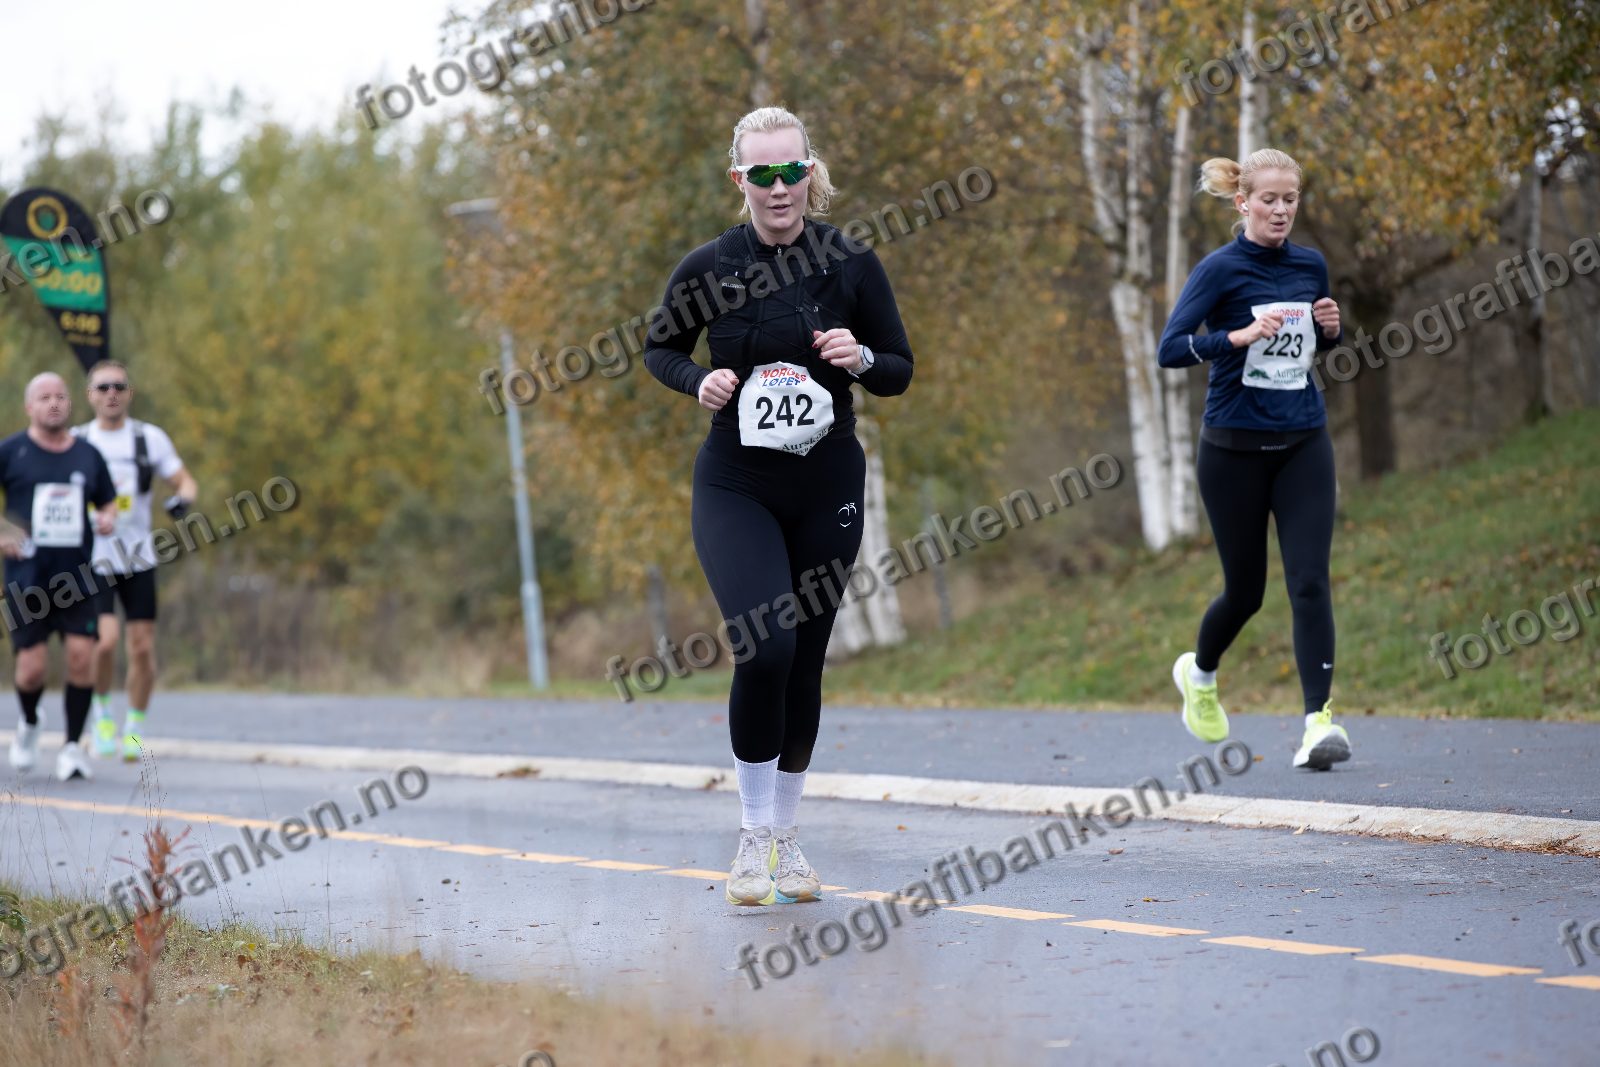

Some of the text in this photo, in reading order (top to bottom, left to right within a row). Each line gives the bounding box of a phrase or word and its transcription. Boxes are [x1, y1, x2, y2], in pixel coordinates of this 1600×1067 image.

[1262, 332, 1304, 359] 223
[760, 367, 807, 382] NORGES
[755, 393, 815, 430] 242
